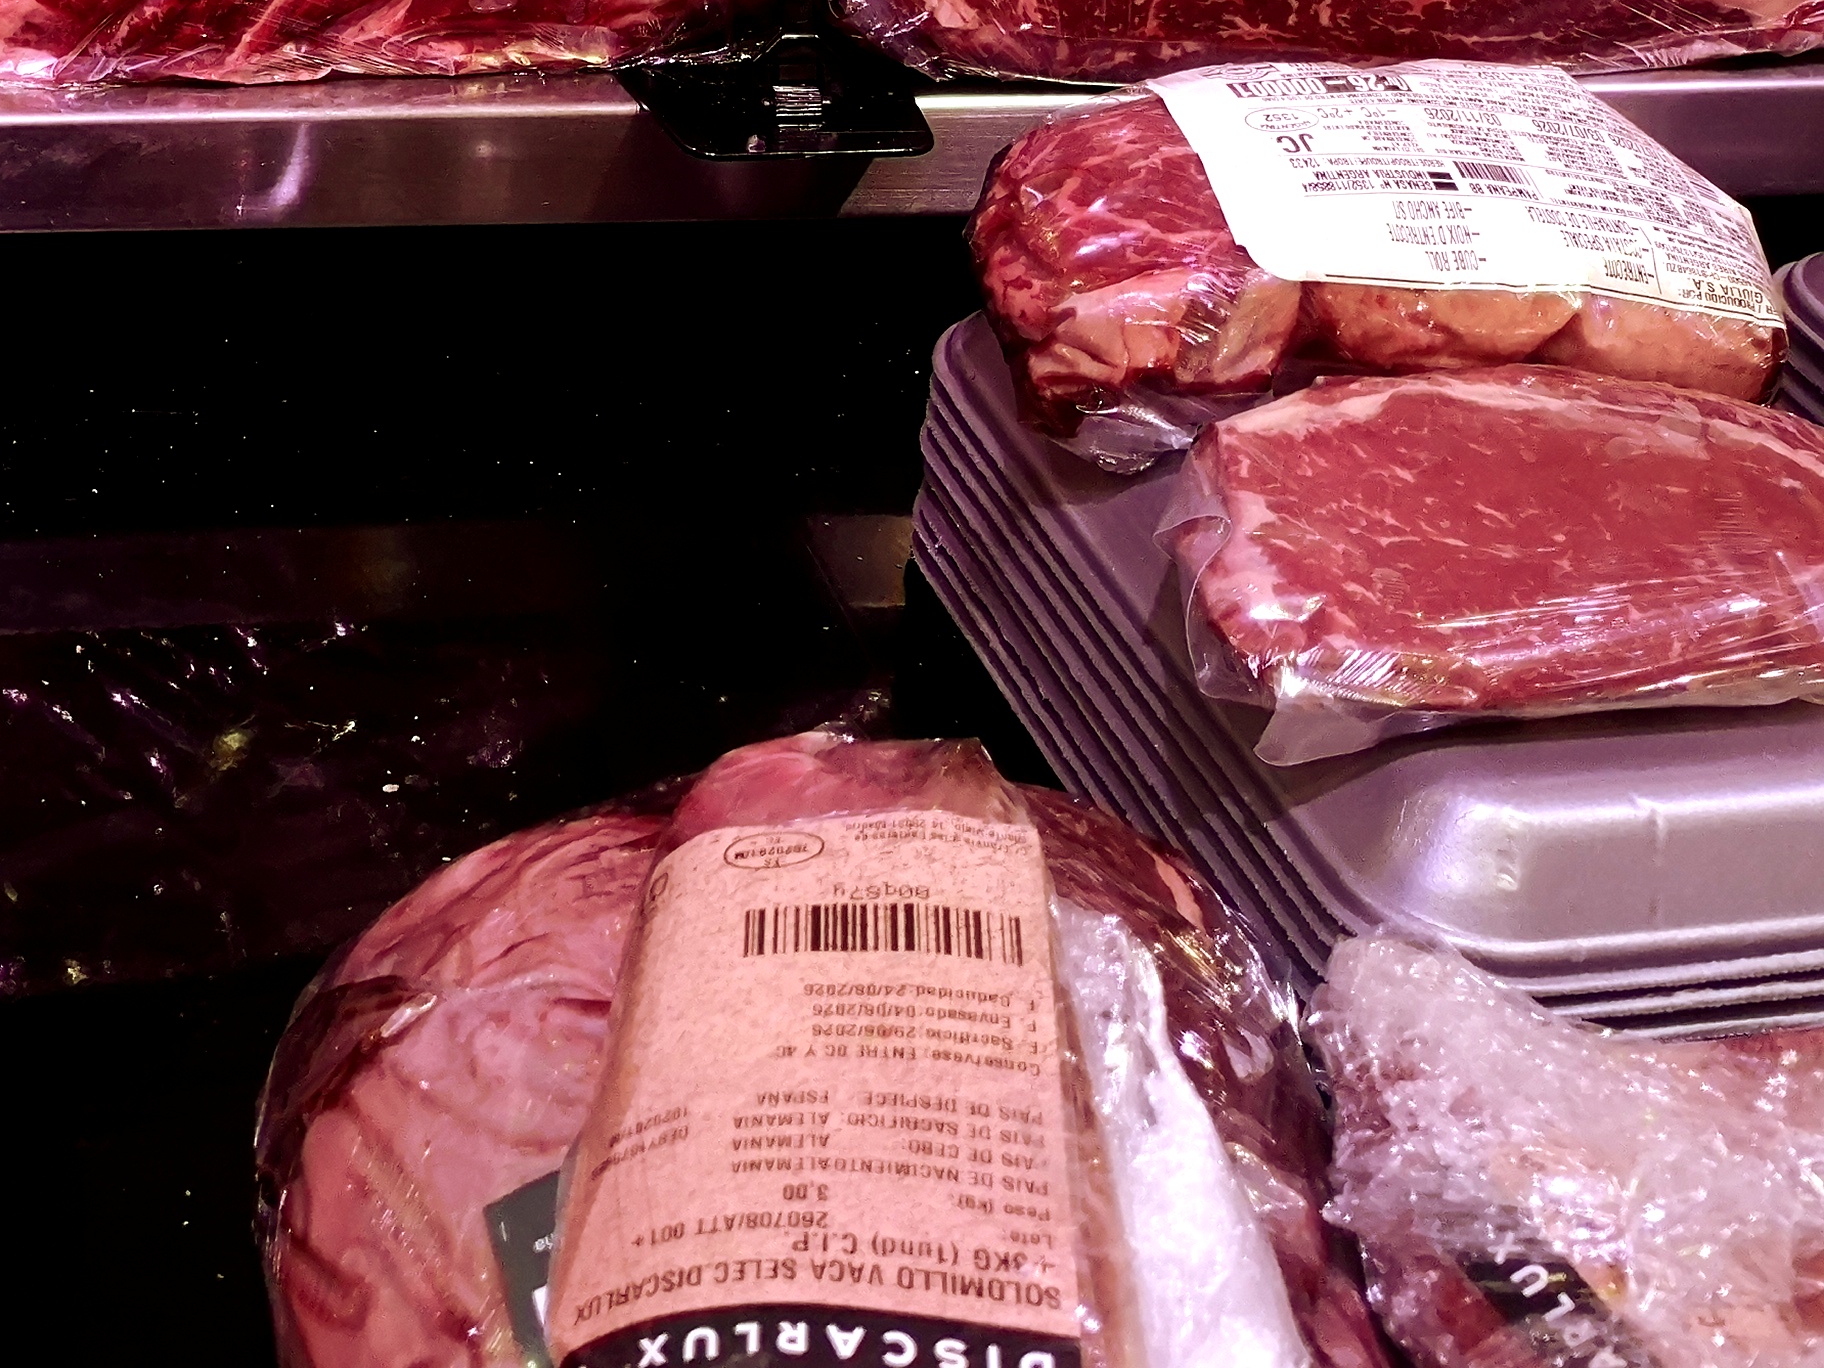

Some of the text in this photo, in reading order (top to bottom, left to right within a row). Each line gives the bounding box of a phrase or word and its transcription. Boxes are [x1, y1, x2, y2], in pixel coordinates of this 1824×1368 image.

[1263, 112, 1300, 121] 1352
[1424, 107, 1503, 126] 03/11/2026
[1532, 118, 1606, 142] 03/07/2026
[1277, 133, 1314, 153] JC
[1313, 170, 1428, 180] INDUSTRIA ARGENTINA
[1397, 180, 1433, 191] SENASA
[1409, 201, 1441, 220] ANCHO
[1425, 250, 1451, 271] ROLL
[1721, 285, 1764, 304] GIULIA
[803, 1043, 816, 1057] Y
[857, 1044, 917, 1061] ENTRE
[731, 1110, 830, 1129] ALEMANIA
[967, 1102, 991, 1119] DE
[967, 1123, 992, 1141] DE
[731, 1133, 830, 1151] ALEMANIA
[967, 1145, 992, 1164] DE
[969, 1171, 994, 1189] DE
[1001, 1177, 1051, 1197] PAIS
[1003, 1200, 1051, 1222] Peso
[872, 1235, 960, 1264] (1und)
[973, 1246, 1032, 1271] 3KG
[812, 1259, 882, 1288] VACA
[574, 1265, 703, 1324] DISCARLUX
[897, 1268, 1062, 1310] SOLOMILLO
